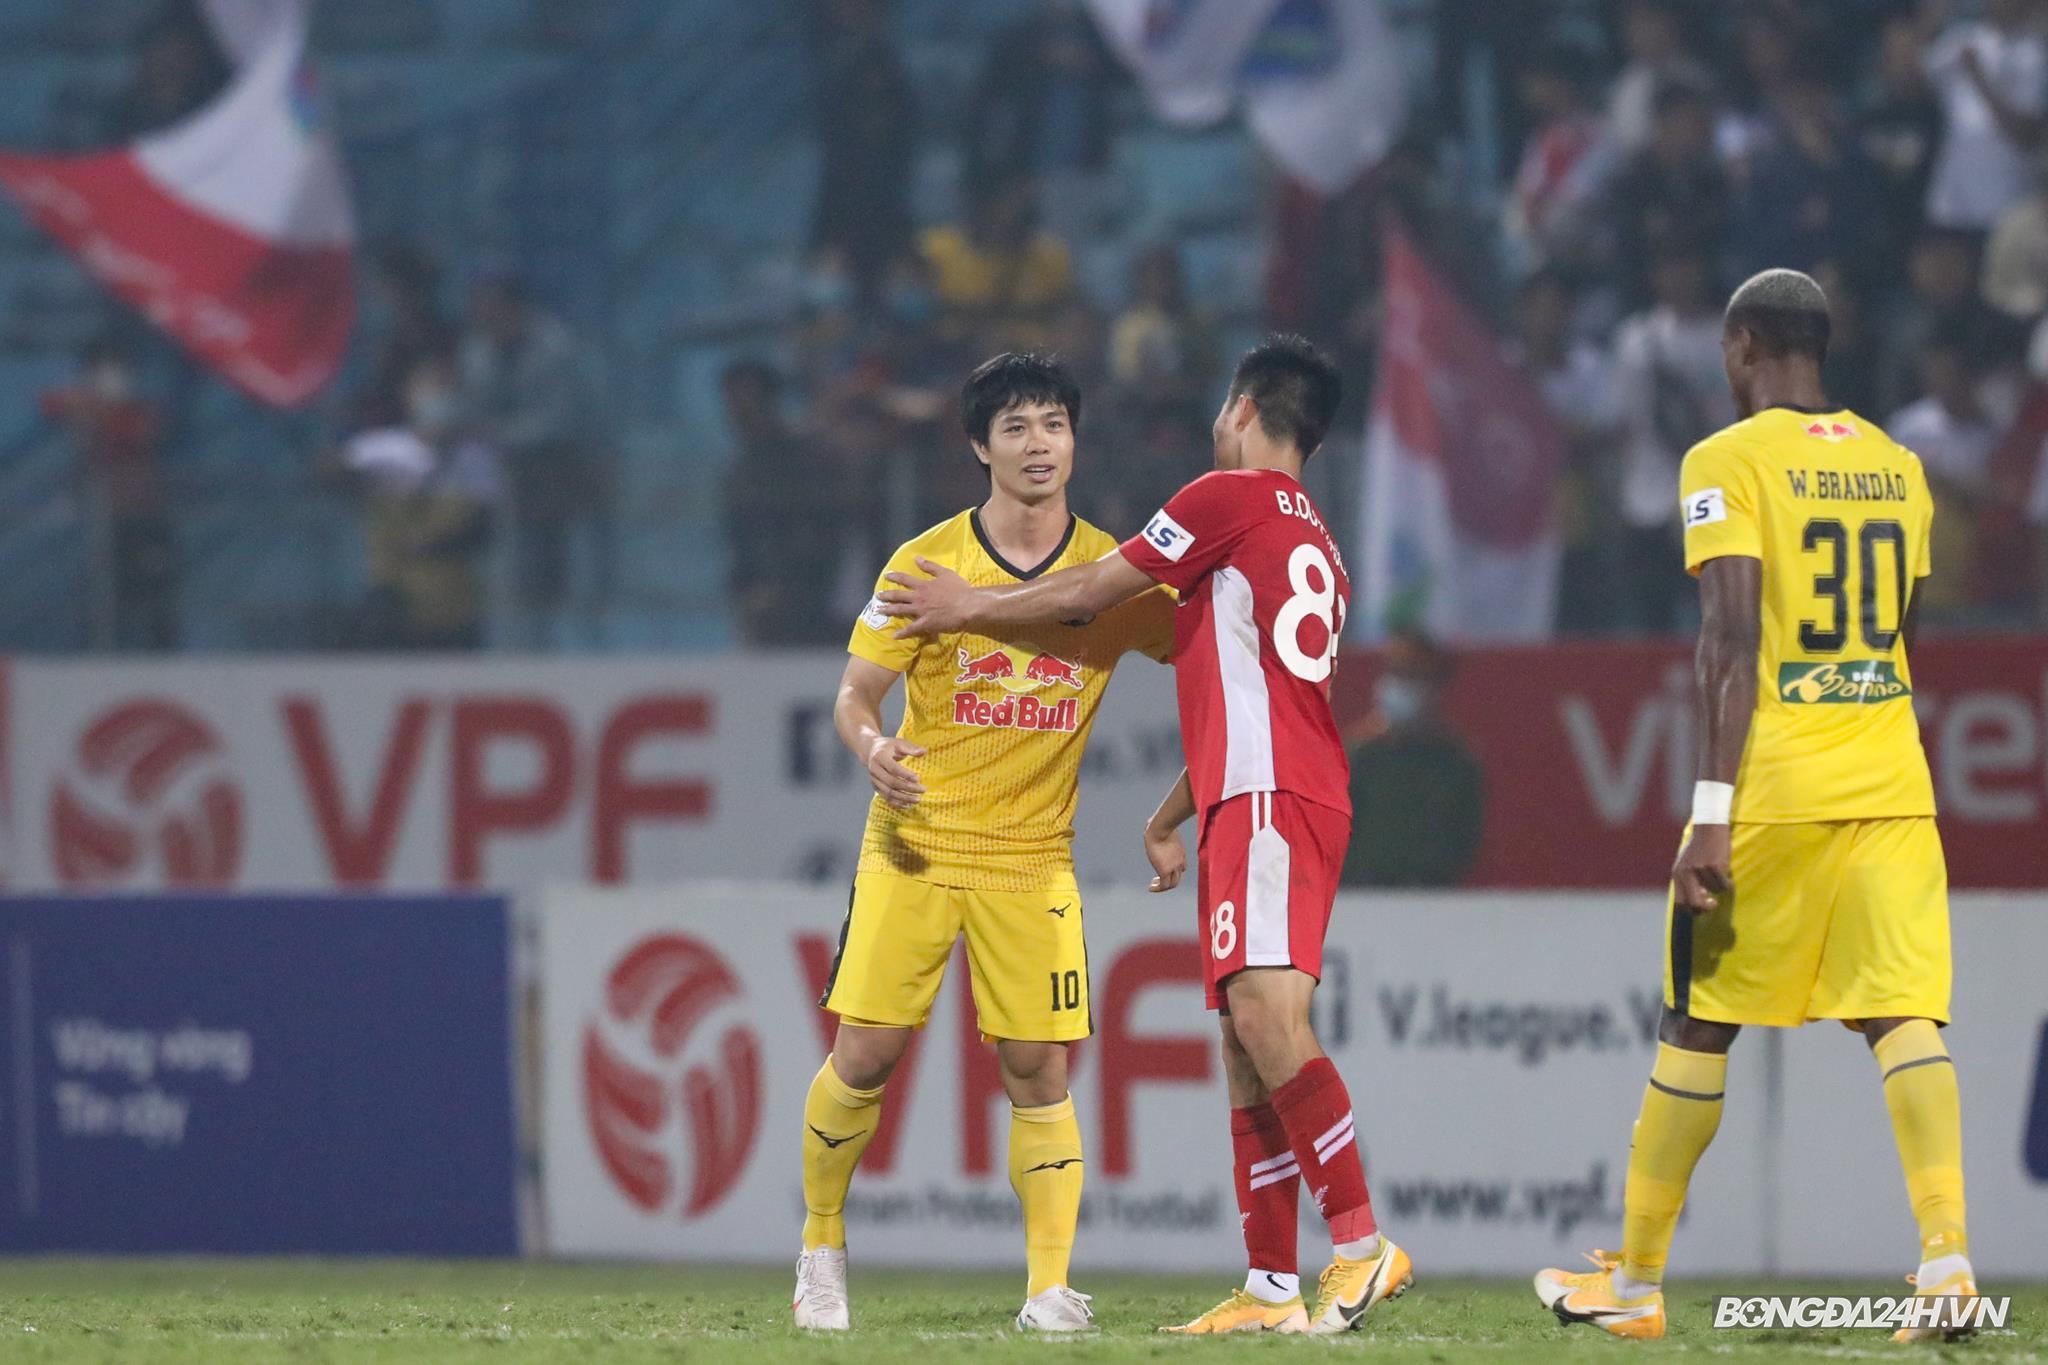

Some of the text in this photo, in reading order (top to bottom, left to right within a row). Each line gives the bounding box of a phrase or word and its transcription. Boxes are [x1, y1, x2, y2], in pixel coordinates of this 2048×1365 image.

[1146, 519, 1178, 547] LS
[1273, 543, 1347, 683] 8
[1797, 517, 1907, 654] 30
[953, 692, 1079, 733] Red Bull
[280, 691, 718, 889] VPF
[1209, 900, 1237, 960] 8
[1050, 970, 1079, 1011] 10
